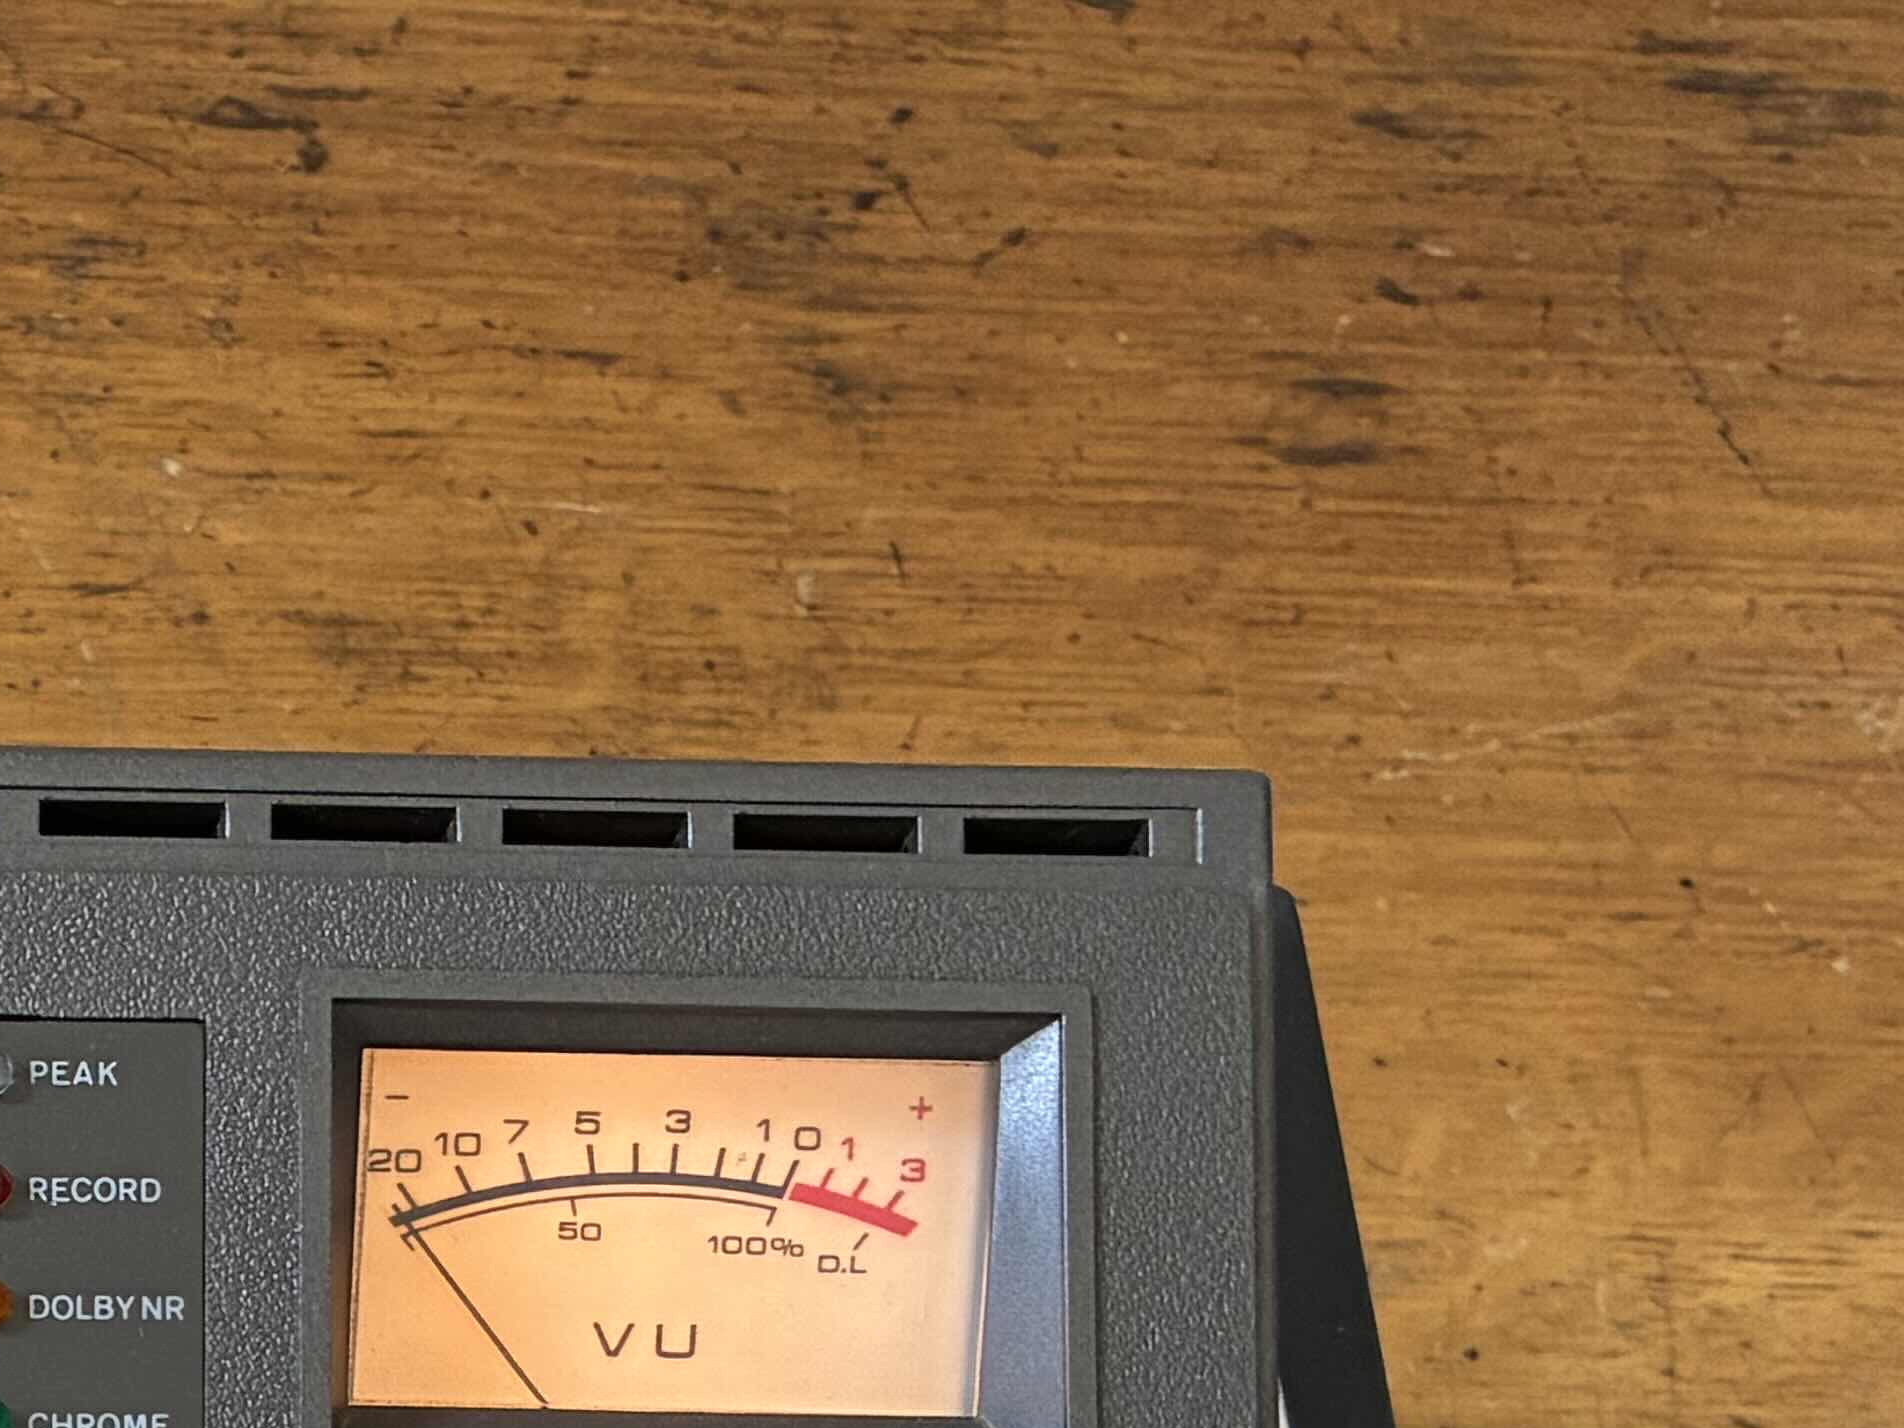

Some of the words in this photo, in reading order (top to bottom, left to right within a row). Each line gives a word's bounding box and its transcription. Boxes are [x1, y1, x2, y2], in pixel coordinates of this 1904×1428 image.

[29, 1060, 118, 1086] PEAK
[366, 1147, 423, 1174] 20
[434, 1132, 482, 1157] 10
[503, 1118, 530, 1145] 7
[574, 1110, 601, 1135] 5
[665, 1109, 692, 1134] 3
[756, 1118, 771, 1142] 1
[794, 1126, 822, 1151] 0
[840, 1136, 855, 1161] 1
[899, 1157, 927, 1183] 3
[29, 1176, 162, 1207] RECORD
[558, 1221, 602, 1242] 50
[707, 1235, 805, 1258] 100%
[29, 1294, 135, 1321] DOLBY
[141, 1295, 185, 1321] NR
